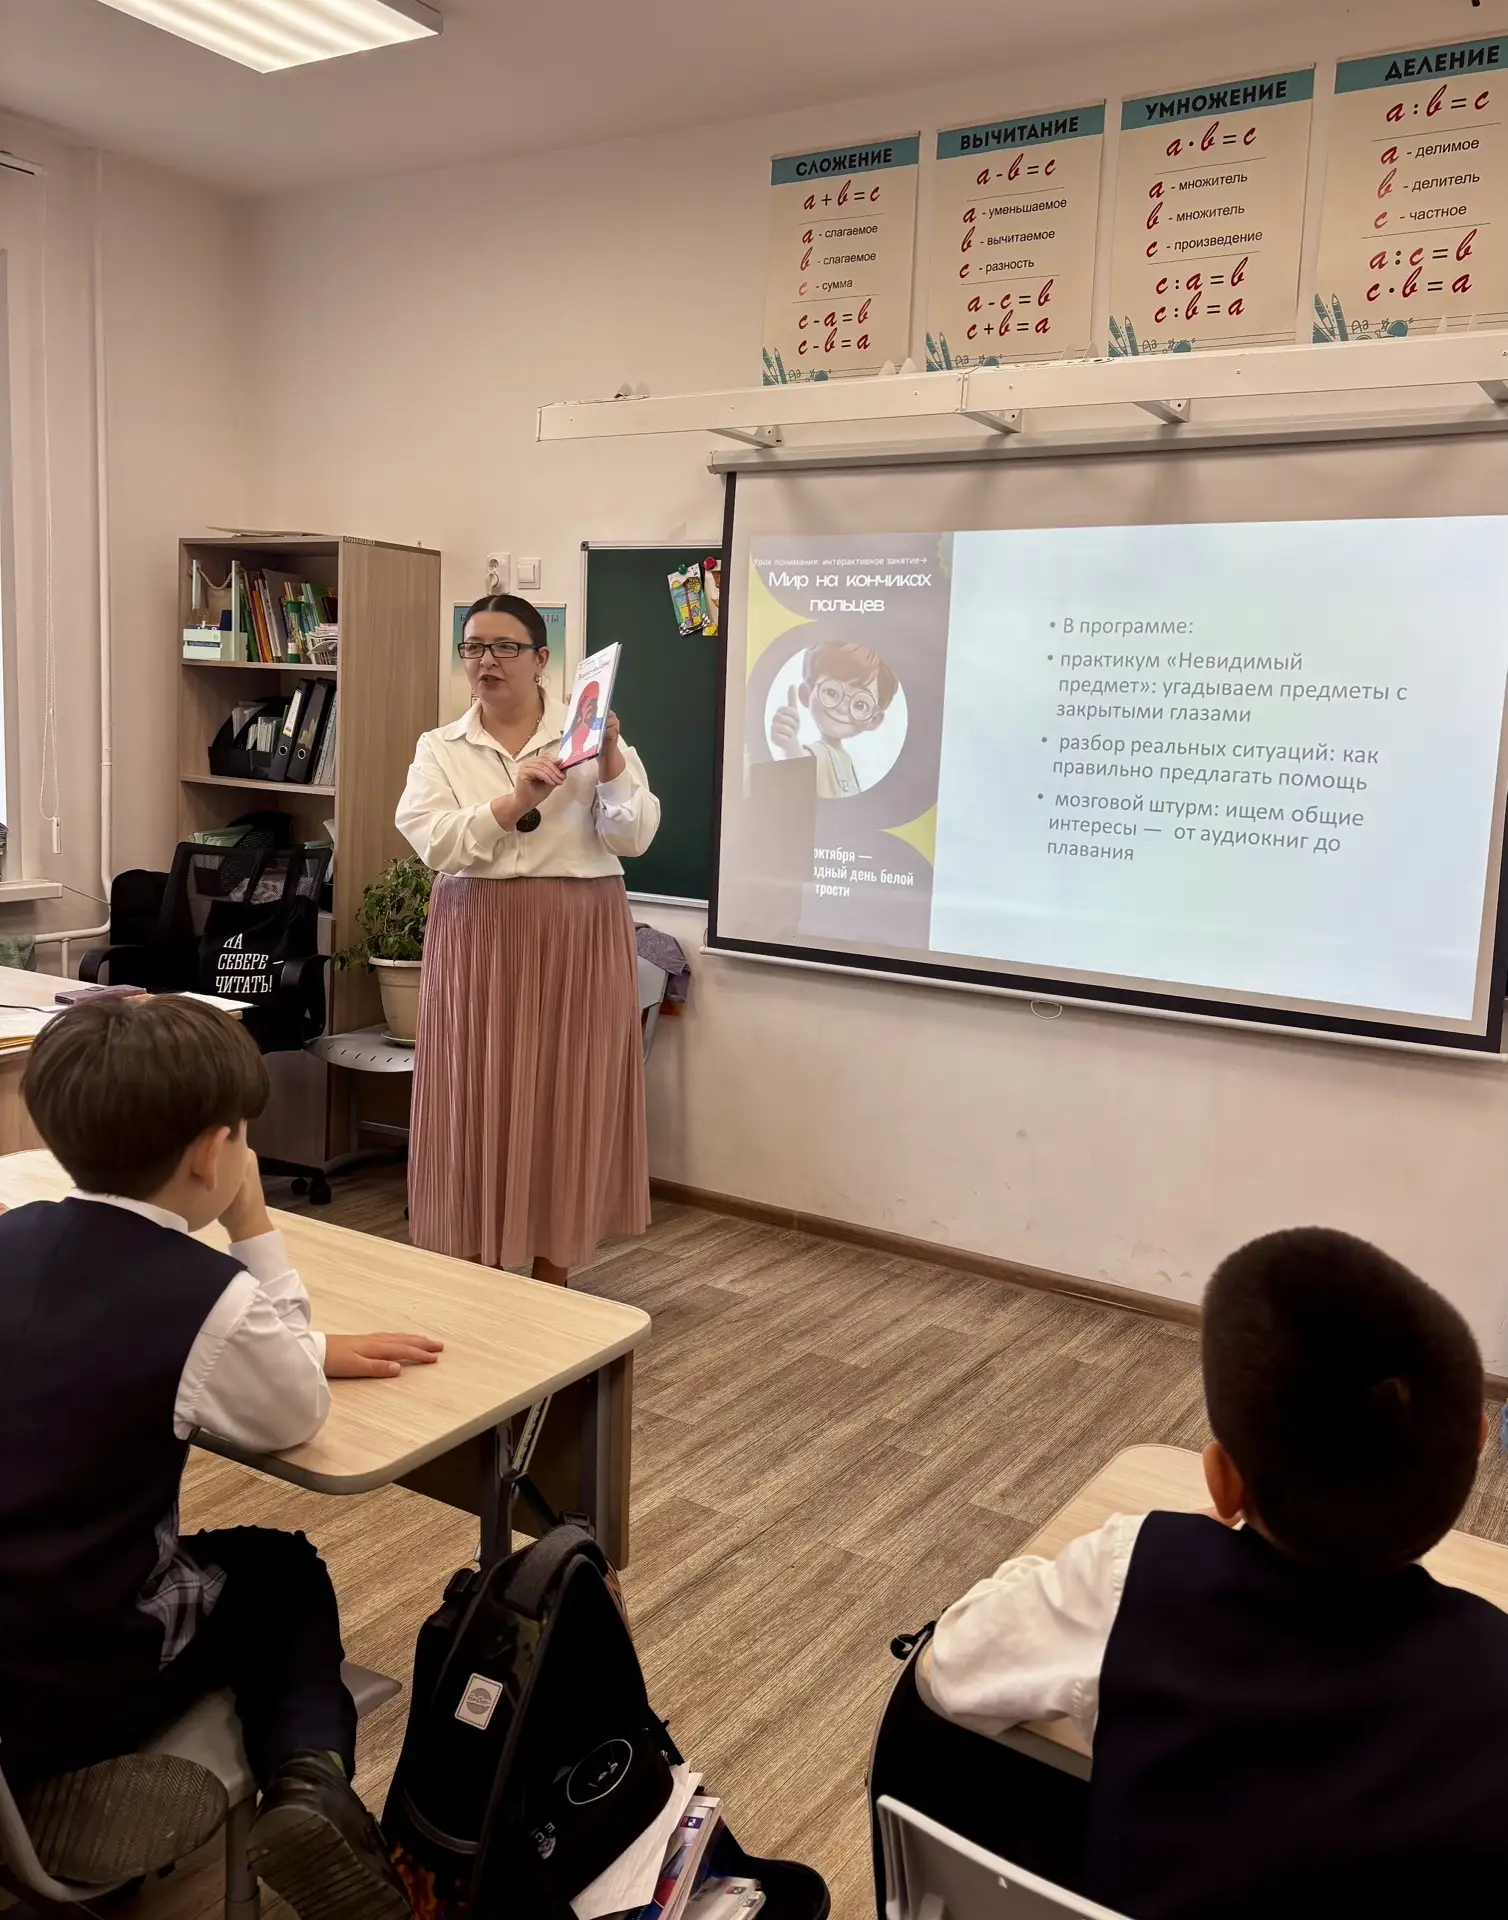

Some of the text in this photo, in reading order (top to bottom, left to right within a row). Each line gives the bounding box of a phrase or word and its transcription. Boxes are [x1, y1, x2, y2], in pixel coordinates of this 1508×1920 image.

[1385, 45, 1500, 82] ДЕЛЕНИЕ
[1145, 80, 1287, 121] УМНОЖЕНИЕ
[960, 116, 1079, 151] ВЫЧИТАНИЕ
[1415, 137, 1480, 158] делимое
[796, 148, 893, 177] СЛОЖЕНИЕ
[1178, 172, 1248, 192] множитель
[1411, 171, 1480, 193] делитель
[988, 198, 1068, 219] уменьшаемое
[1176, 203, 1245, 223] множитель
[1409, 204, 1467, 221] частное
[825, 224, 878, 239] слагаемое
[987, 229, 1056, 247] вычитаемое
[1174, 230, 1263, 252] произведение
[823, 252, 877, 266] слагаемое
[986, 258, 1035, 275] разность
[822, 279, 853, 292] сумма
[768, 571, 932, 590] Мир на кончиках
[809, 599, 885, 614] пальцев
[1063, 617, 1194, 637] В программе:
[1060, 651, 1303, 672] практикум «Невидимый
[1059, 679, 1407, 702] предмет»: угадываем предметы с
[1056, 703, 1251, 723] закрытыми глазами
[1059, 734, 1379, 764] разбор реальных ситуаций: как
[1053, 761, 1367, 793] правильно предлагать помощь
[1055, 794, 1364, 828] мозговой штурм: ищем общие
[1049, 817, 1137, 836] интересы
[1174, 827, 1196, 840] от
[1200, 830, 1309, 849] аудиокниг
[1313, 837, 1341, 854] до
[1047, 842, 1134, 860] плавания
[850, 869, 877, 882] день
[880, 869, 914, 886] белой
[815, 883, 850, 897] трости
[217, 953, 269, 970] СЕВЕРЕ
[215, 974, 273, 993] ЧИТАТЬ!
